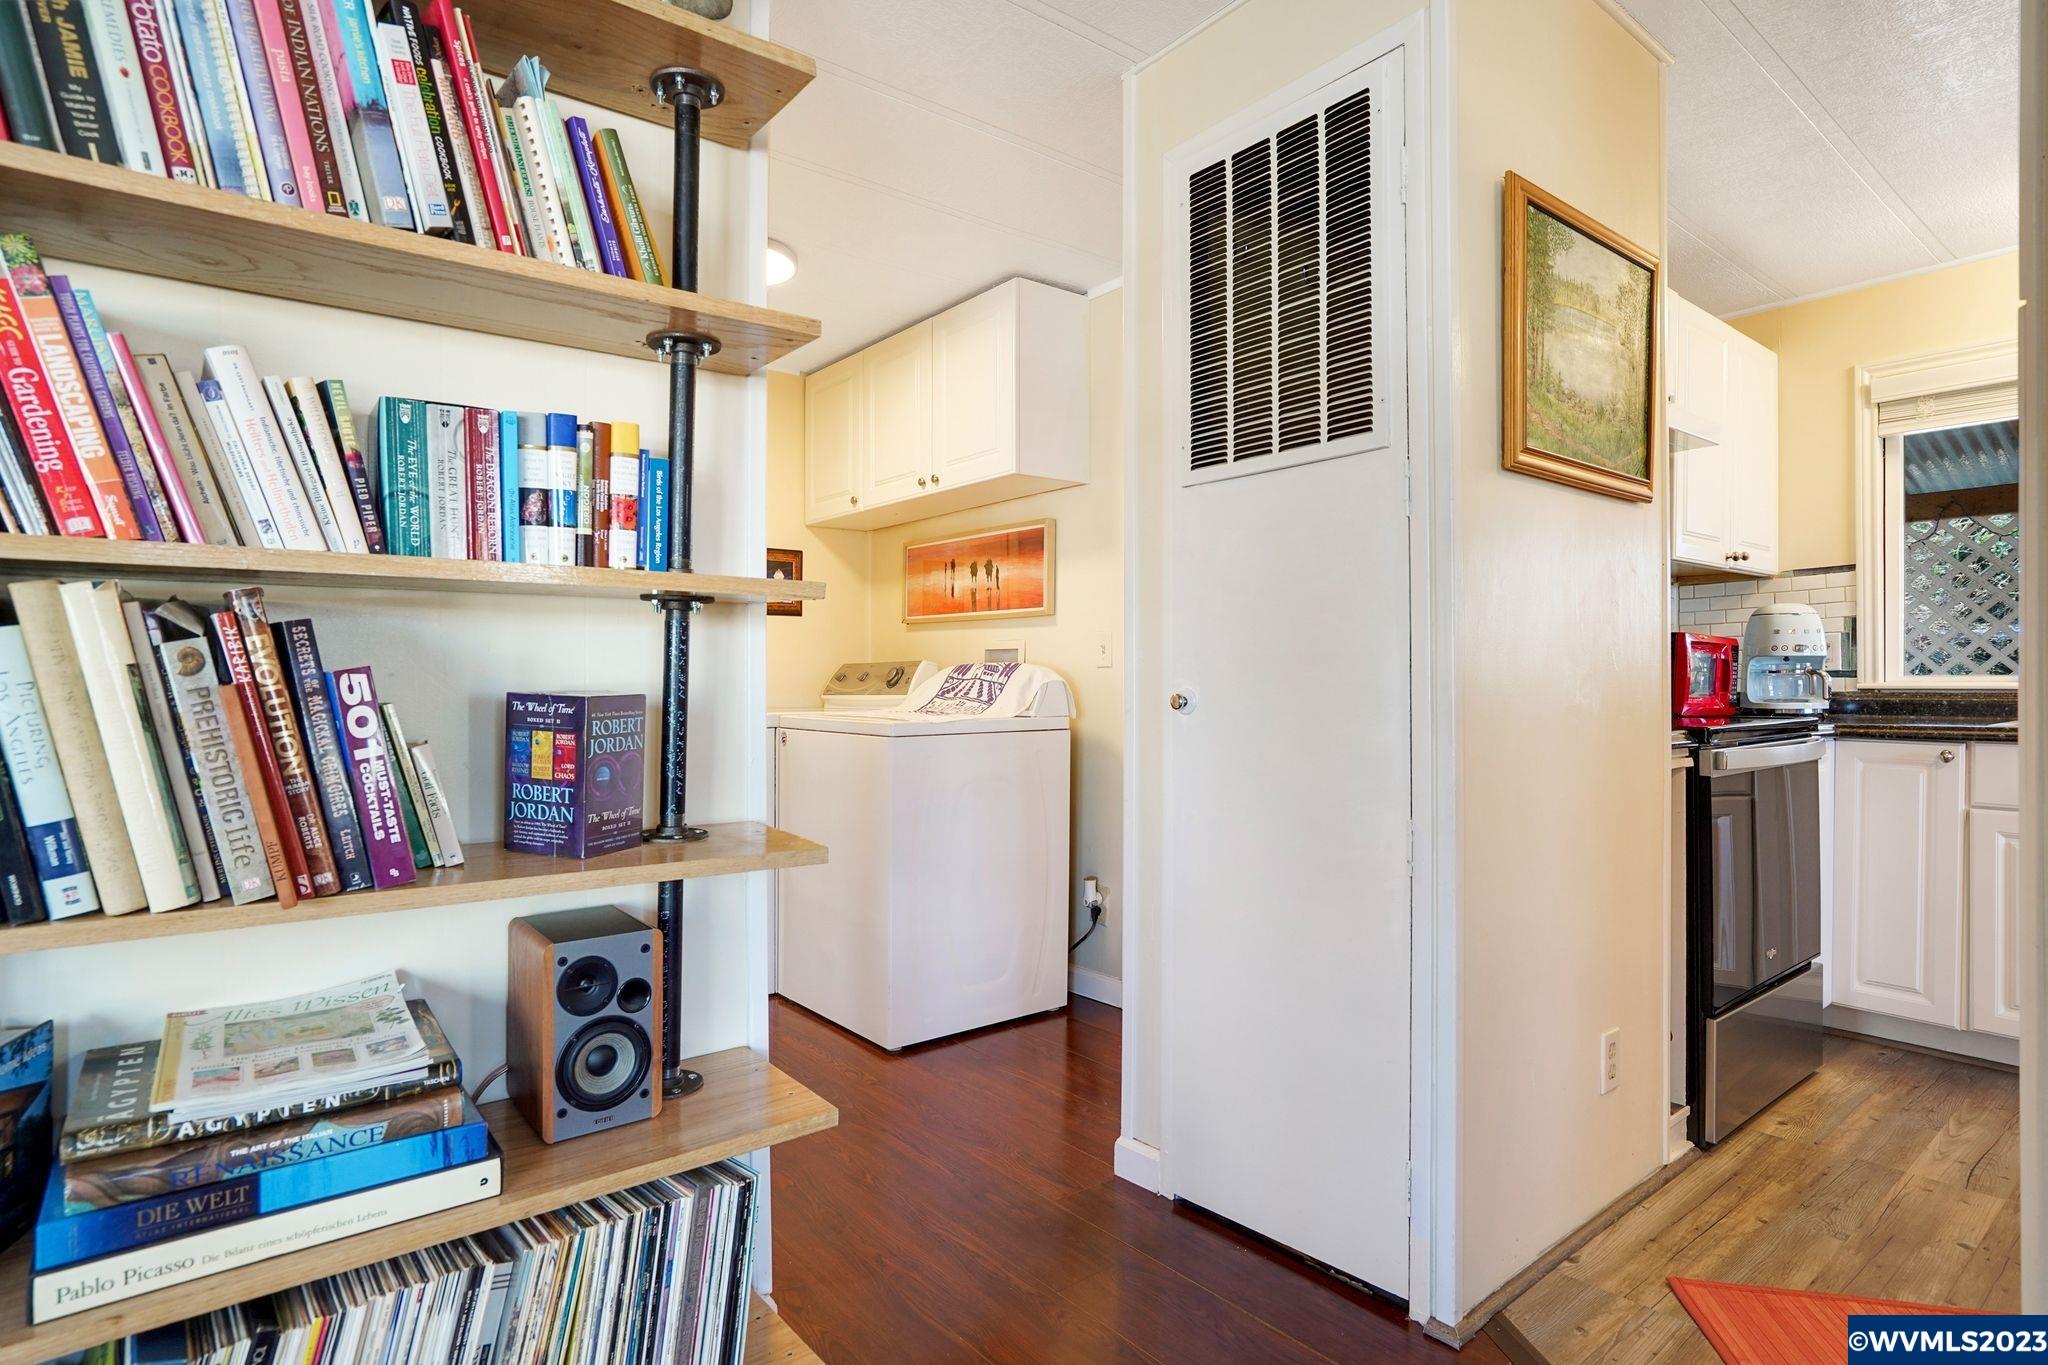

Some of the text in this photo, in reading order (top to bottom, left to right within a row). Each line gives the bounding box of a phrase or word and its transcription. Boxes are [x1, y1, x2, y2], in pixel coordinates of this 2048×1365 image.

[402, 5, 417, 36] NATIVE
[56, 17, 89, 79] JAMIE
[271, 49, 291, 83] pasta
[408, 36, 424, 66] FOODS
[453, 40, 466, 67] Spices
[288, 17, 312, 78] INDIAN
[303, 84, 330, 153] NATIONS
[415, 67, 437, 136] celebration
[148, 64, 188, 164] COOKBOOK
[434, 136, 453, 180] COOKBOOK
[529, 197, 546, 248] HOUSE PLANTS
[627, 202, 649, 259] Khalil Gibrans
[68, 314, 83, 337] PLANTS
[81, 353, 106, 389] CALIFORNIA
[97, 390, 116, 420] GARDENS
[36, 333, 105, 459] LANDSCAPING
[158, 382, 170, 402] Farbe
[7, 366, 64, 474] Gardening
[175, 425, 188, 443] denn
[331, 382, 356, 448] NEVIL SHUTE
[408, 440, 417, 455] The
[408, 456, 417, 477] EYE
[447, 450, 457, 466] The
[116, 449, 144, 501] FELDER RUSHING
[200, 480, 211, 505] Aichele
[244, 417, 300, 541] Heiltees Heilmethoden
[259, 416, 311, 537] Indianische, tibetische und chinesische
[398, 454, 408, 529] ROBERT JORDAN
[437, 459, 447, 532] ROBERT JORDAN
[448, 467, 458, 502] GREAT
[104, 494, 126, 528] Sunset
[317, 500, 332, 526] Kleine
[354, 477, 378, 533] PIED PIPER
[475, 463, 486, 534] ROBERT JORDAN
[485, 446, 498, 562] The DRAGON REBORN
[582, 485, 590, 525] OREGON
[409, 504, 421, 547] WORLD
[654, 517, 662, 541] Angeles
[654, 542, 662, 564] Region
[223, 625, 252, 683] KARIBIK
[16, 680, 51, 770] PICTURING
[246, 634, 307, 778] EVOLUTION
[339, 672, 385, 761] 501
[512, 701, 575, 716] The Wheel of Time
[592, 717, 644, 736] ROBERT
[7, 711, 34, 786] ANGELES
[292, 626, 317, 677] SECRETS
[306, 693, 333, 753] MAGICKAL
[322, 754, 349, 819] GRIMOIRES
[340, 828, 357, 861] LEITCH
[588, 734, 644, 759] JORDAN
[187, 686, 256, 871] PREHISTORIC life
[288, 788, 309, 796] STORY
[512, 783, 574, 804] ROBERT
[554, 772, 575, 780] CHAOS
[359, 762, 385, 842] COCKTAILS
[373, 756, 402, 844] MUST-TASTE
[427, 789, 441, 819] Facts
[509, 801, 574, 823] JORDAN
[588, 806, 641, 824] The Wheel of Time
[298, 816, 313, 850] ROBERTS
[309, 829, 323, 849] ALICE
[265, 840, 288, 882] KUMPF
[212, 979, 391, 1023] Alles Wissen
[98, 1045, 146, 1123] ÄGYPTEN
[423, 1076, 452, 1087] TASCHEN
[171, 1123, 386, 1191] RENAISSANCE
[230, 1128, 334, 1158] THE ART OF THE ITALIAN
[136, 1184, 250, 1230] DIE WELT
[170, 1206, 250, 1233] INTERNATIONAL
[56, 1208, 388, 1305] Pablo Picasso Die Bilanz eines schöpferischen Lebens
